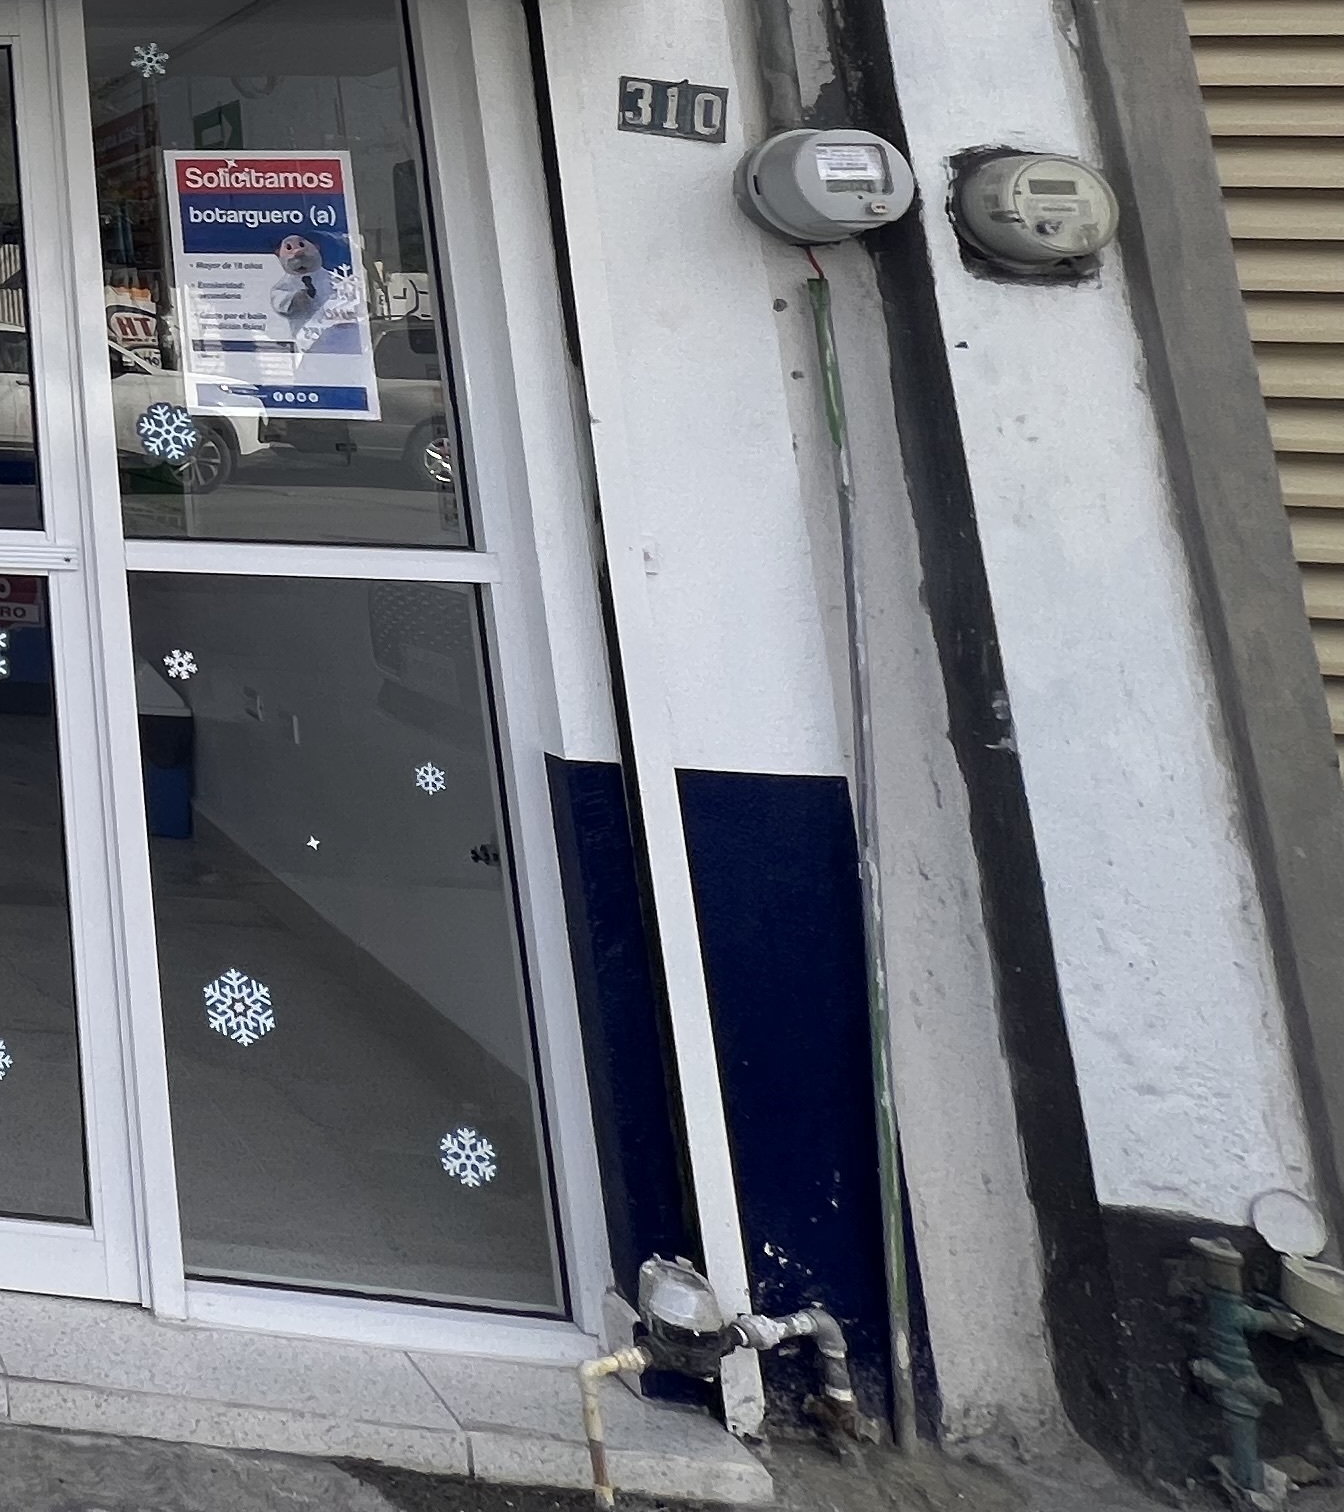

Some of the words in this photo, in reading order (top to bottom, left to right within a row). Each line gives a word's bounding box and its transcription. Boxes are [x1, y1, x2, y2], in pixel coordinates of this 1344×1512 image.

[625, 79, 722, 136] 310
[185, 167, 334, 189] Solicitamos
[189, 205, 304, 228] botarguero
[309, 204, 337, 227] (a)
